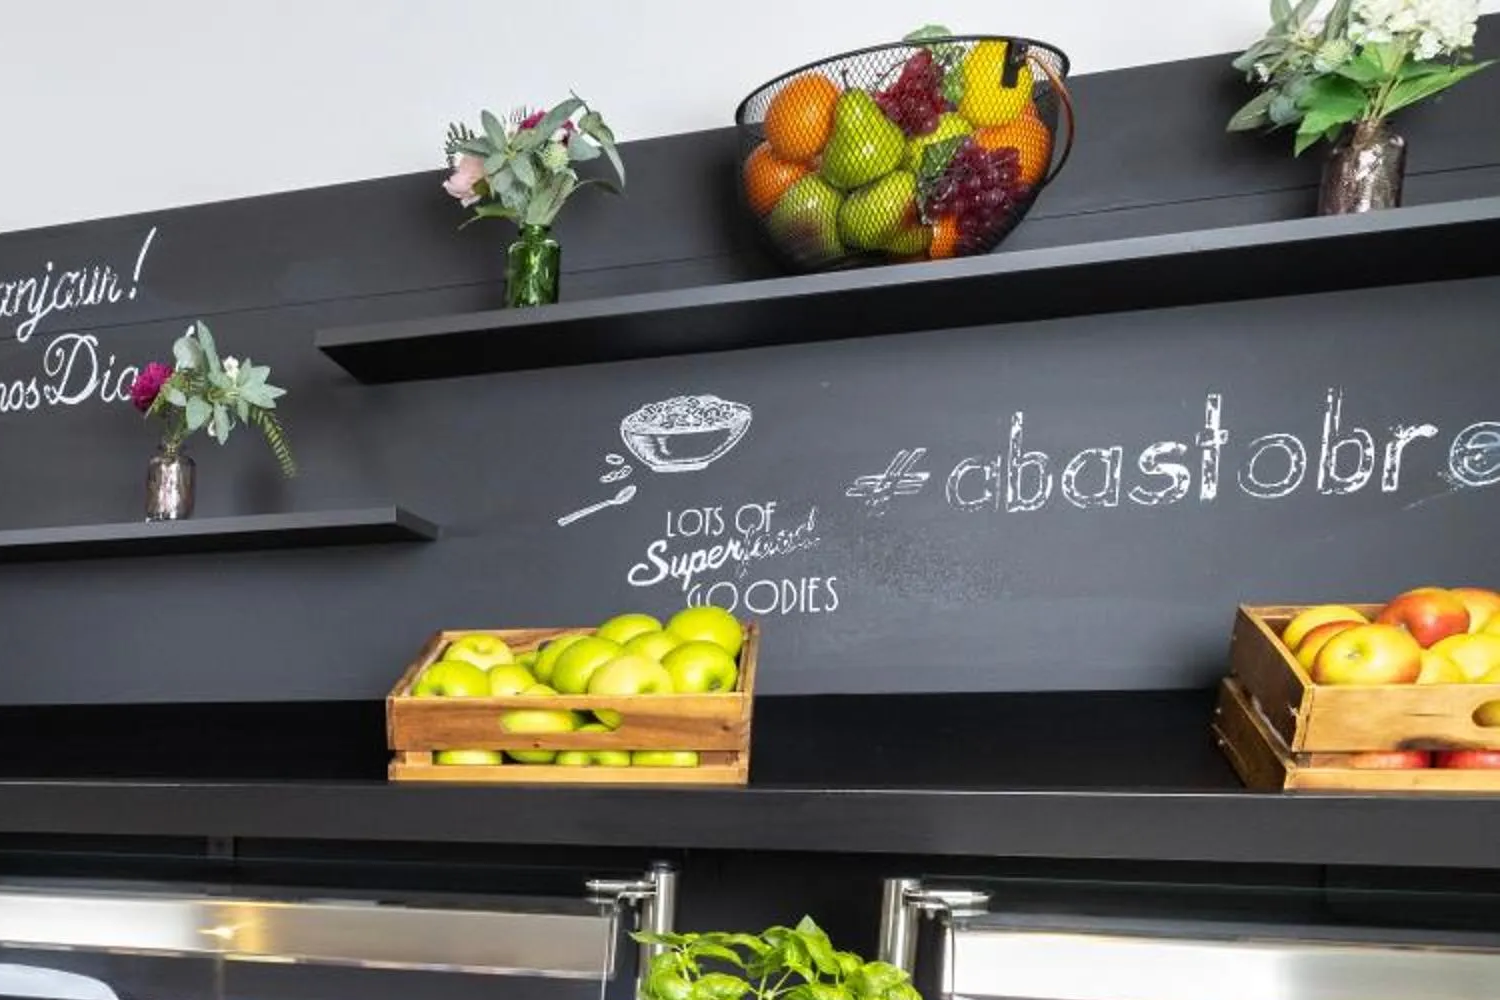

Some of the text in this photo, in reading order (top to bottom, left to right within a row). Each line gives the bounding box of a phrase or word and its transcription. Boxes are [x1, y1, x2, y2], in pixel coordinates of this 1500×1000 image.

[43, 333, 140, 405] Dia
[666, 501, 777, 538] LOTS OF
